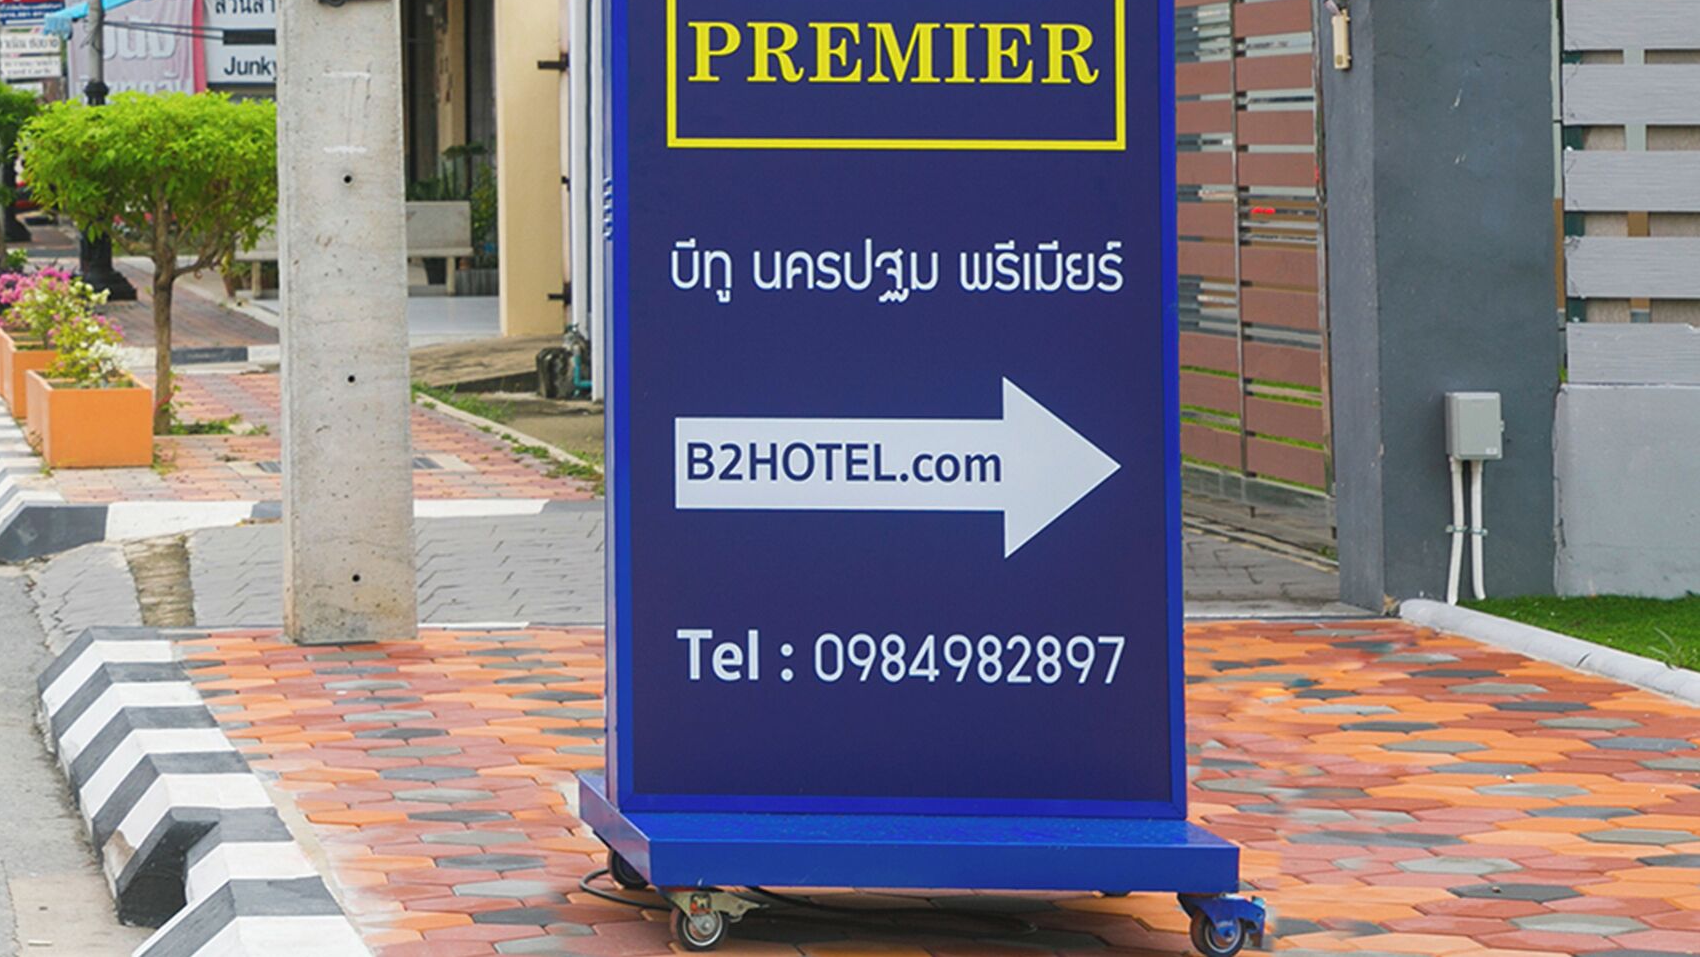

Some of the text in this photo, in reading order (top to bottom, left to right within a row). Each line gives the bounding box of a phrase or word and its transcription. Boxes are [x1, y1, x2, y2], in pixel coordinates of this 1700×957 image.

[688, 21, 1099, 84] PREMIER
[671, 238, 1124, 303] บีทู นครปฐม พรีเมียร์
[687, 442, 1002, 483] B2HOTEL.com
[676, 629, 759, 681] Tel
[815, 633, 1125, 684] 0984982897
